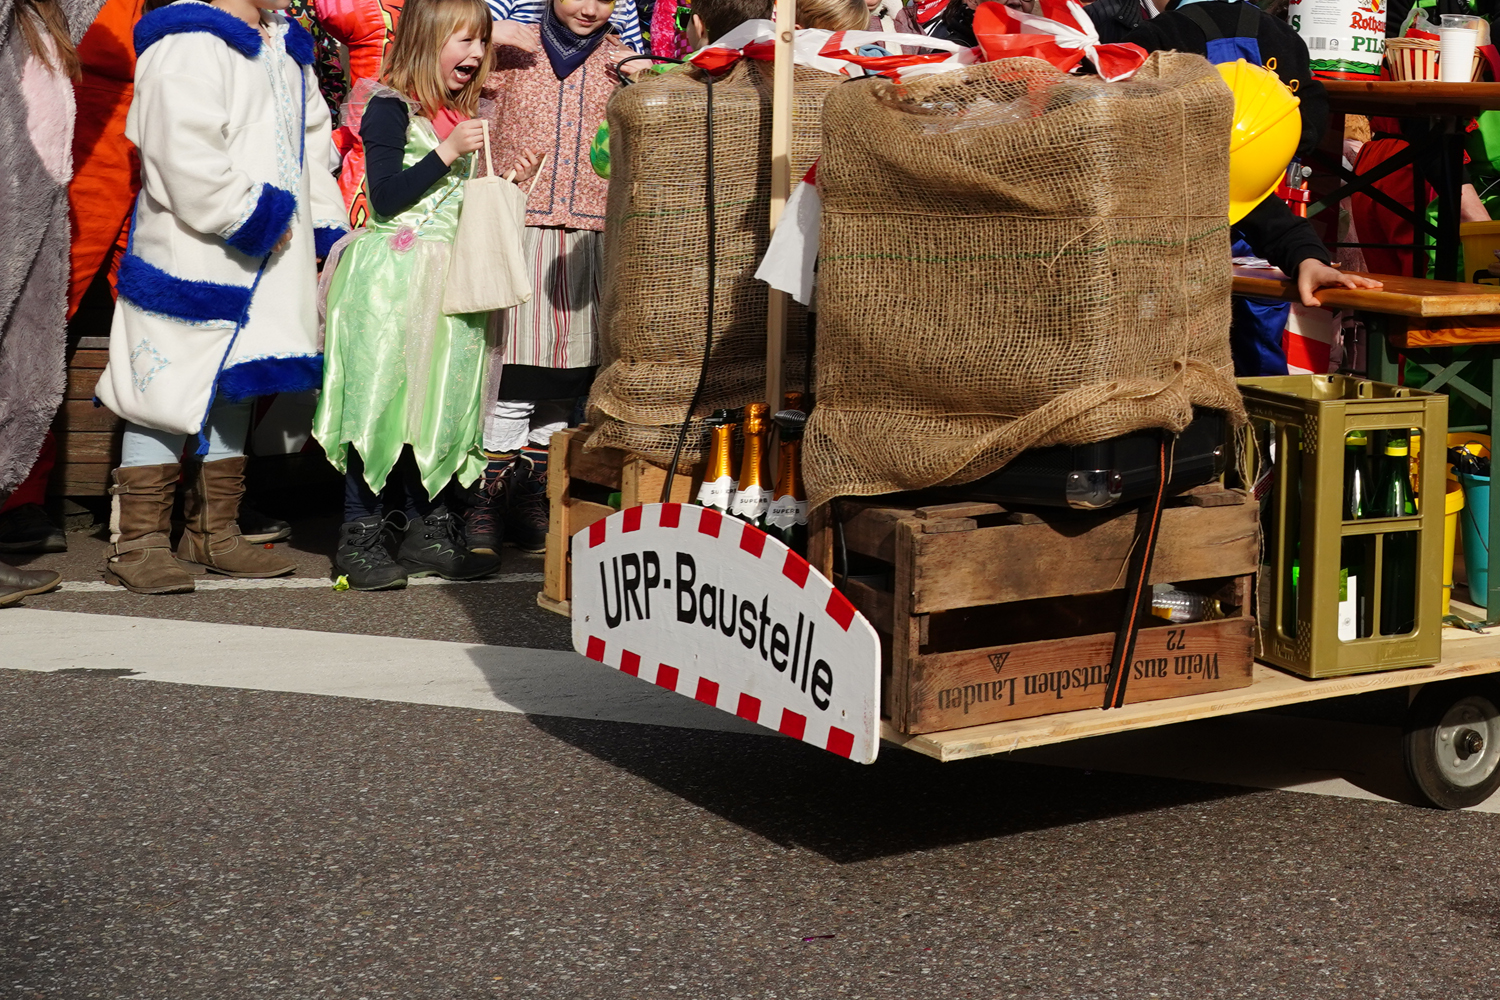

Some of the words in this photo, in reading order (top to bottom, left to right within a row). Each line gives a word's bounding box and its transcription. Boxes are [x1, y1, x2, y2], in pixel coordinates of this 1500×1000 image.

[1349, 11, 1387, 35] Rotha
[1351, 35, 1385, 55] PILS
[600, 550, 833, 711] URP-Baustelle
[1166, 629, 1186, 651] 72
[1133, 657, 1168, 680] aus
[1174, 652, 1221, 680] Wein
[1024, 663, 1112, 699] eutschen
